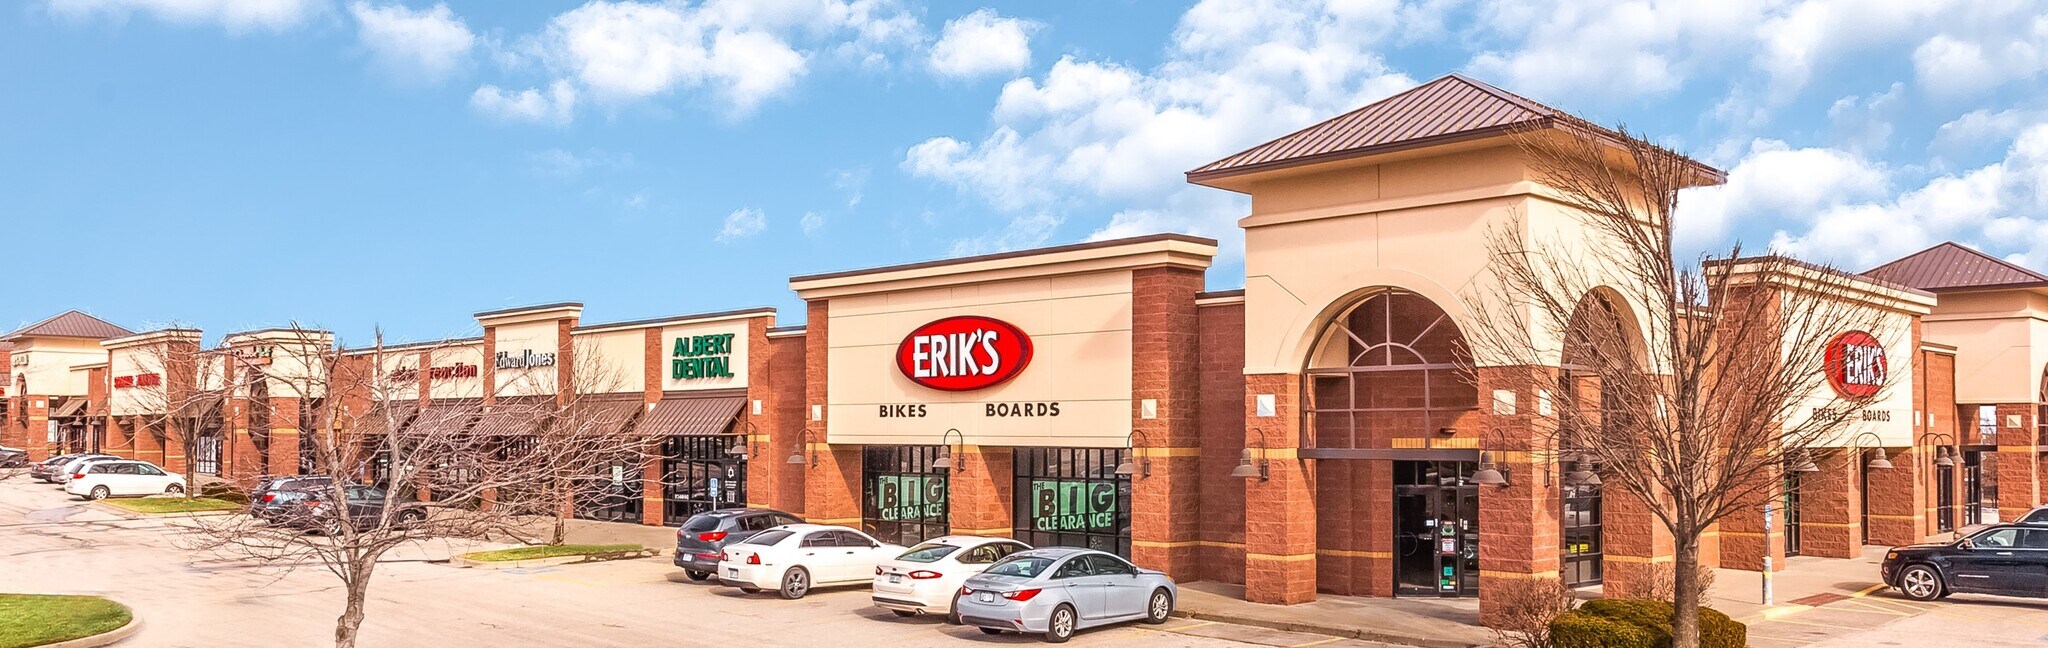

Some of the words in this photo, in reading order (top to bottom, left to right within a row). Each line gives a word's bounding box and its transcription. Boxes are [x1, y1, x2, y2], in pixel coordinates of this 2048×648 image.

[673, 333, 735, 357] ALBERT
[913, 328, 999, 378] ERIK'S
[496, 351, 525, 369] Edward
[524, 349, 556, 370] Jones
[673, 357, 735, 379] DENTAL
[1845, 344, 1884, 386] ERIK'S
[879, 404, 927, 418] BIKES
[985, 402, 1060, 417] BOARDS
[1862, 409, 1891, 421] BOARDS
[884, 477, 944, 509] BIG
[1033, 482, 1046, 491] THE
[1039, 484, 1114, 517] BIG
[882, 503, 942, 520] CLEARANCE
[1037, 513, 1112, 531] CLEARANCE
